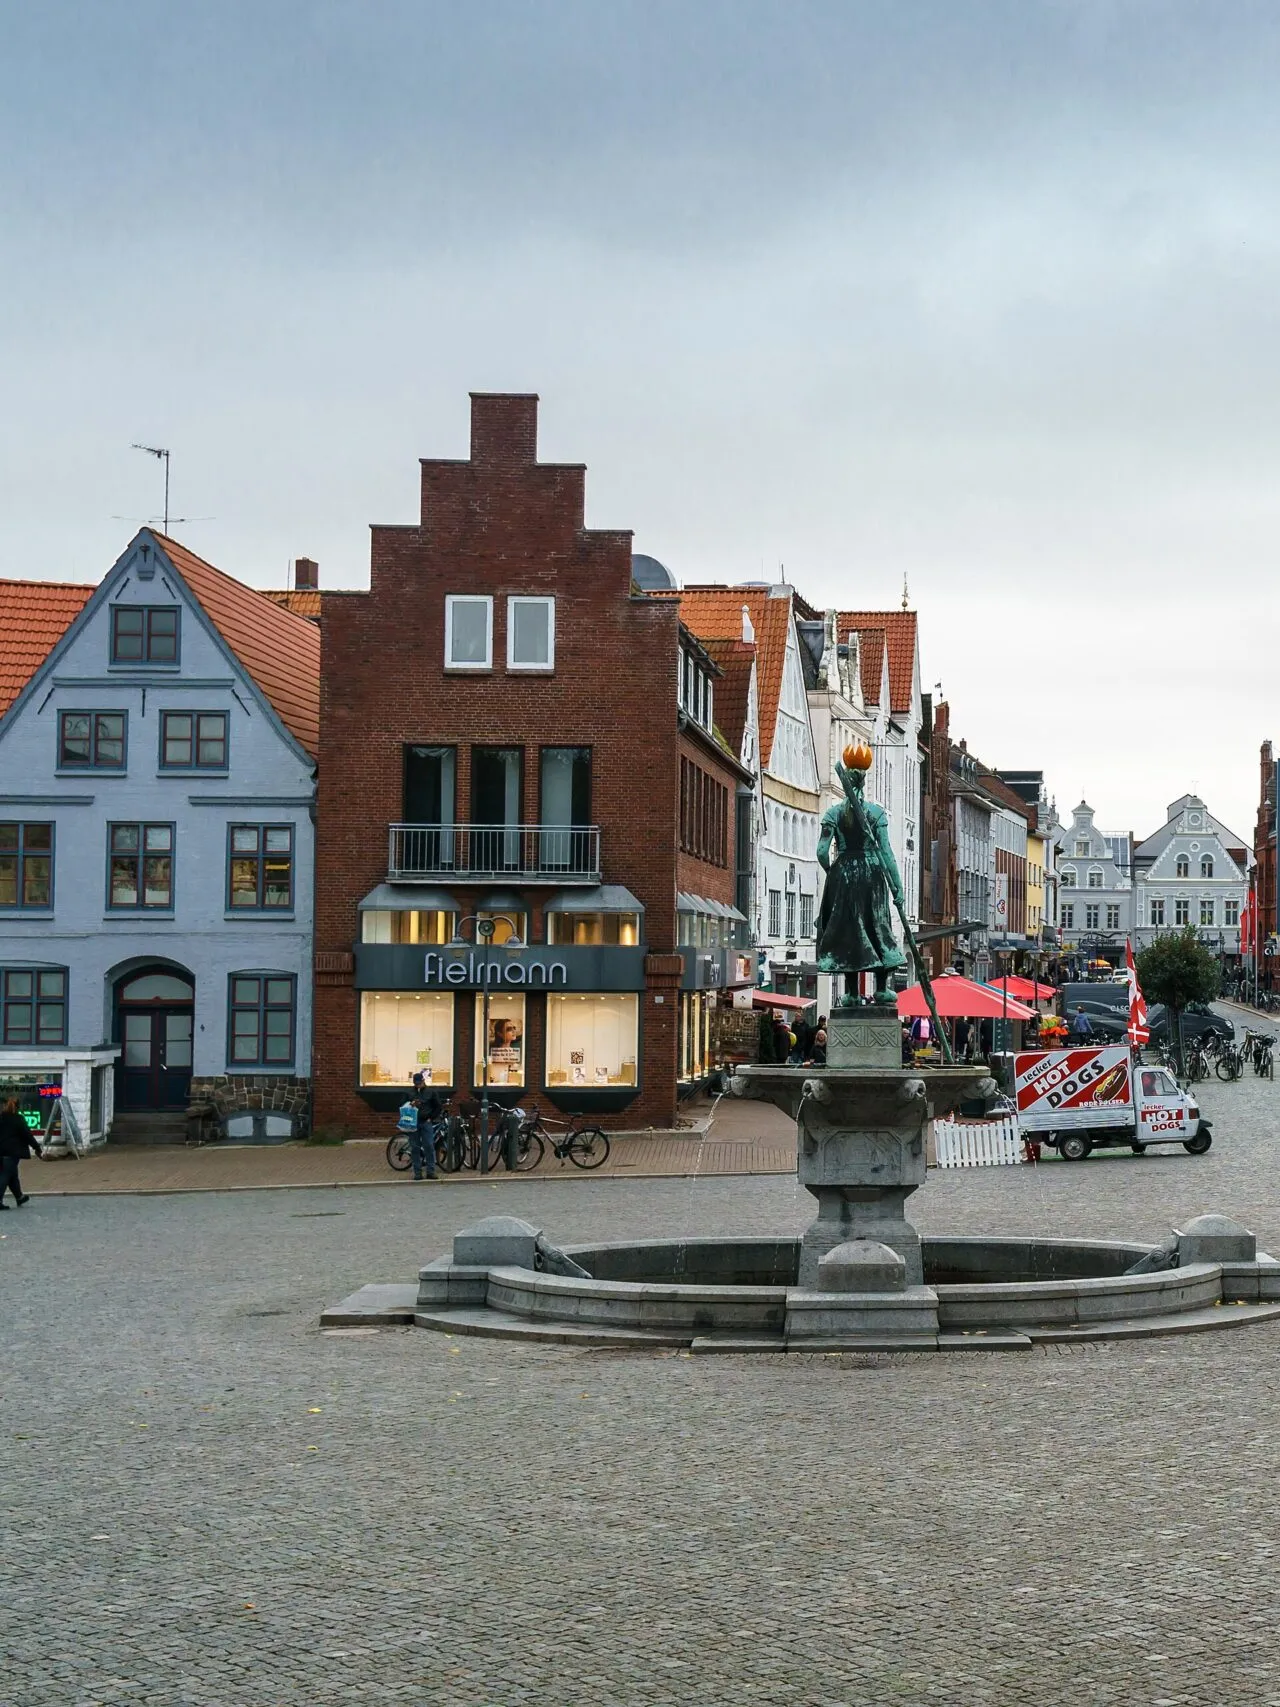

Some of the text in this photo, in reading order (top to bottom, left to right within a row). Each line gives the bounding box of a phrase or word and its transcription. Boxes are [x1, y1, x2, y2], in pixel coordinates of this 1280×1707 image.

[424, 952, 567, 984] fielmann
[1023, 1059, 1052, 1083] lecker
[1032, 1060, 1071, 1096] HOT
[1046, 1060, 1105, 1109] DOGS
[1145, 1109, 1179, 1124] HOT
[1152, 1120, 1181, 1132] DOGS
